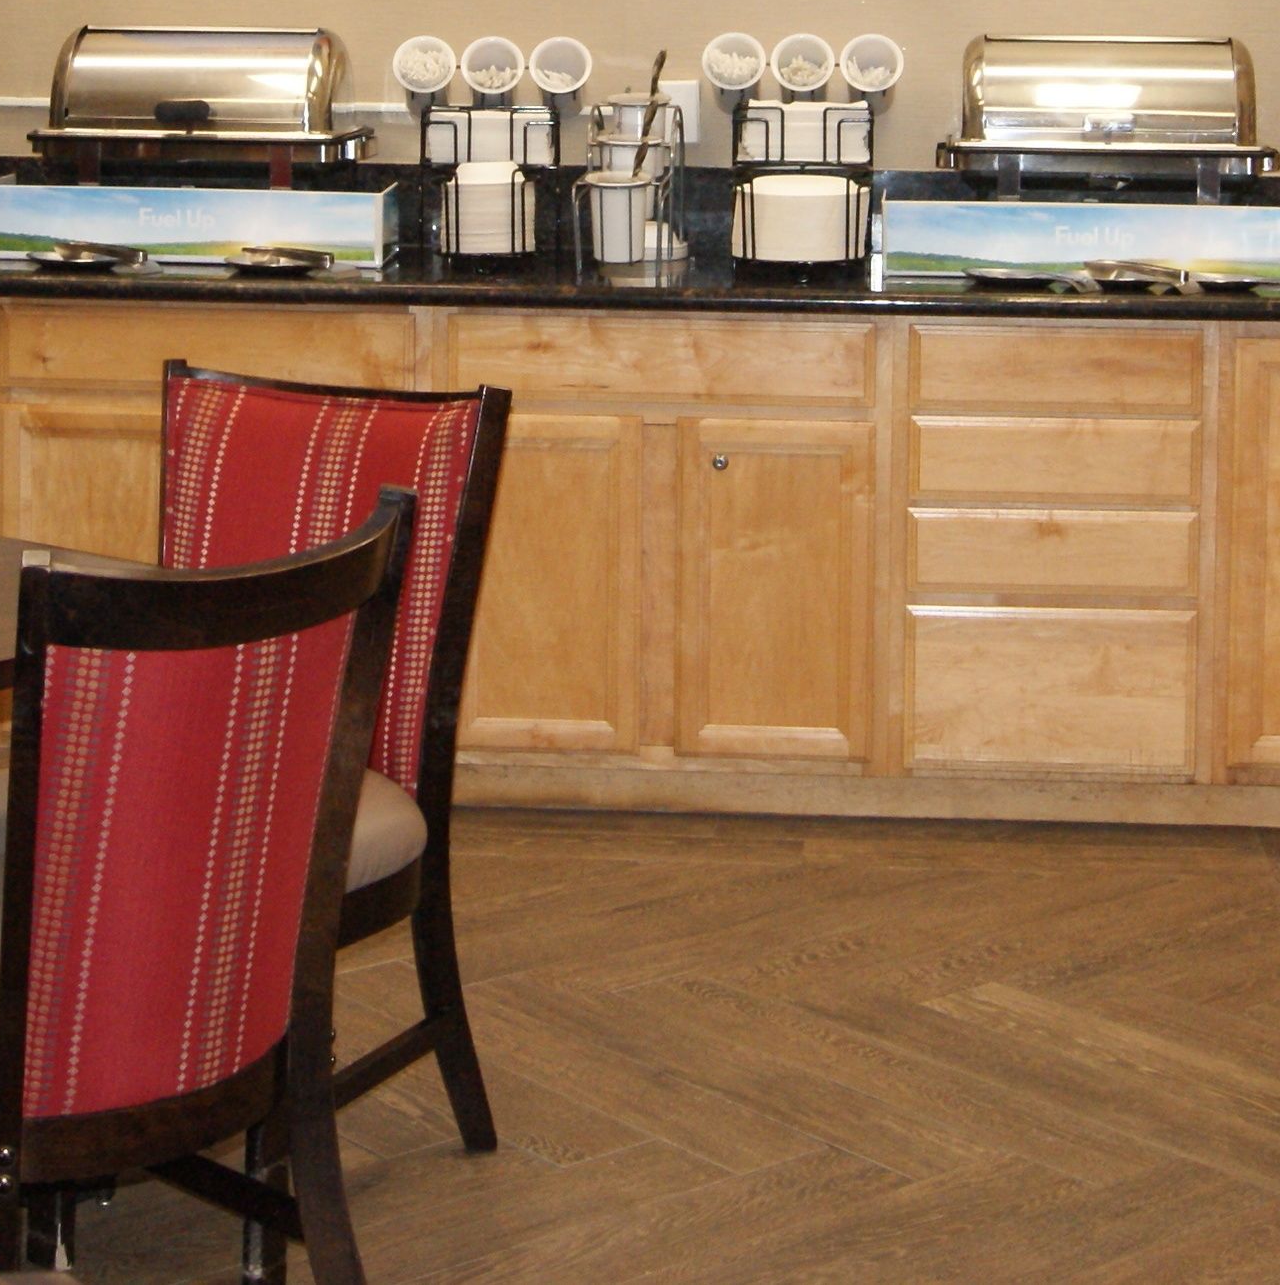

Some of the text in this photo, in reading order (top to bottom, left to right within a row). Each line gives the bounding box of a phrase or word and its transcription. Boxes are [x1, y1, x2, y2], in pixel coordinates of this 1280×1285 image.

[139, 206, 217, 234] Fuel Up
[1055, 225, 1136, 251] Fuel Up
